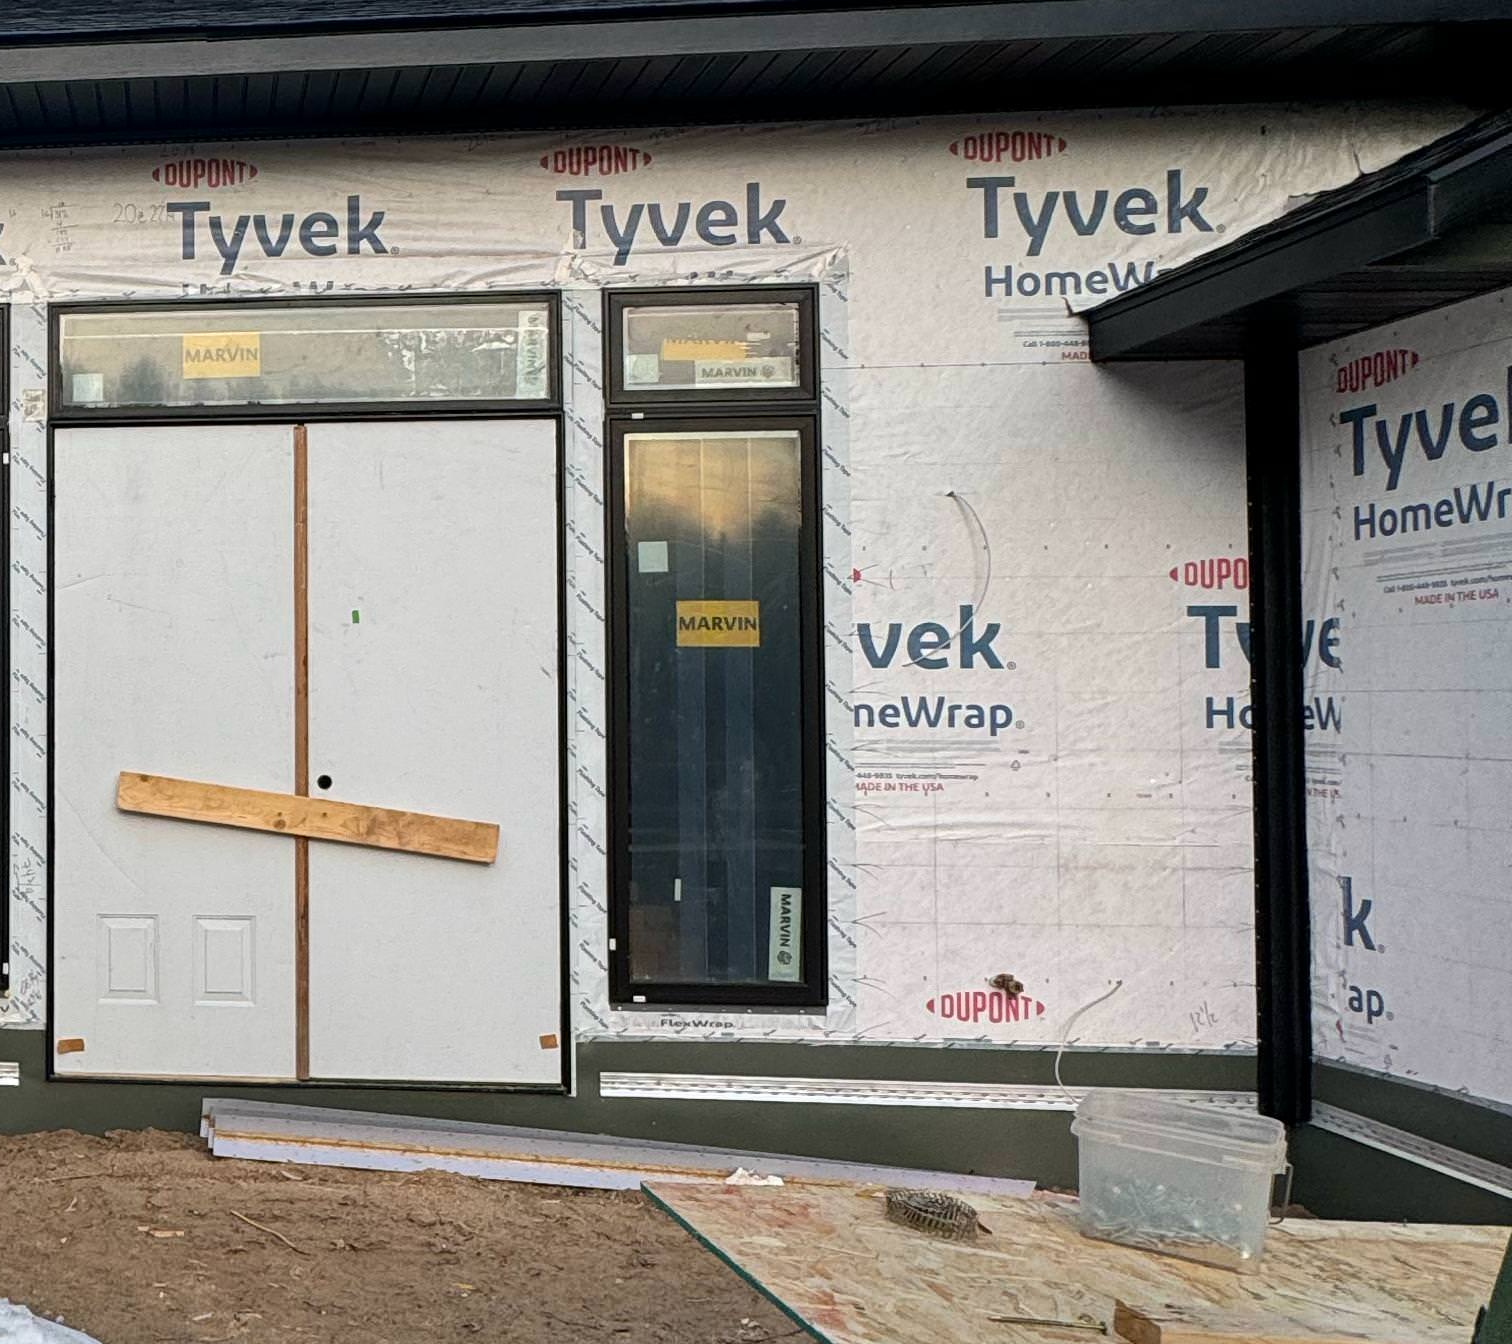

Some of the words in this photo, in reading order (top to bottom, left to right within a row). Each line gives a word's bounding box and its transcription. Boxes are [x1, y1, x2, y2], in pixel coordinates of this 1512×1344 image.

[554, 145, 640, 176] DUPONT
[963, 131, 1056, 162] DUPONT
[164, 158, 246, 189] DUPONT
[555, 182, 790, 266] Tyvek
[967, 169, 1213, 256] Tyvek
[166, 194, 388, 276] Tyvek
[985, 261, 1175, 297] HomeW
[185, 346, 259, 364] MARVIN
[1337, 349, 1408, 393] DUPONT
[701, 367, 757, 378] MARVIN
[1340, 365, 1512, 491] Tyve
[1354, 481, 1512, 541] HomeWr
[1185, 558, 1248, 589] DUPO
[1415, 591, 1444, 605] MADE
[1445, 591, 1456, 602] IN
[1458, 588, 1477, 600] THE
[1479, 587, 1499, 599] USA
[678, 616, 758, 632] MARVIN
[857, 605, 1004, 669] vek
[1206, 697, 1341, 732] HoeW
[884, 783, 896, 792] IN
[899, 783, 920, 792] THE
[922, 783, 945, 793] USA
[781, 893, 793, 948] MARVIN
[941, 990, 1033, 1023] DUPONT
[661, 1018, 733, 1029] FlexWrap
